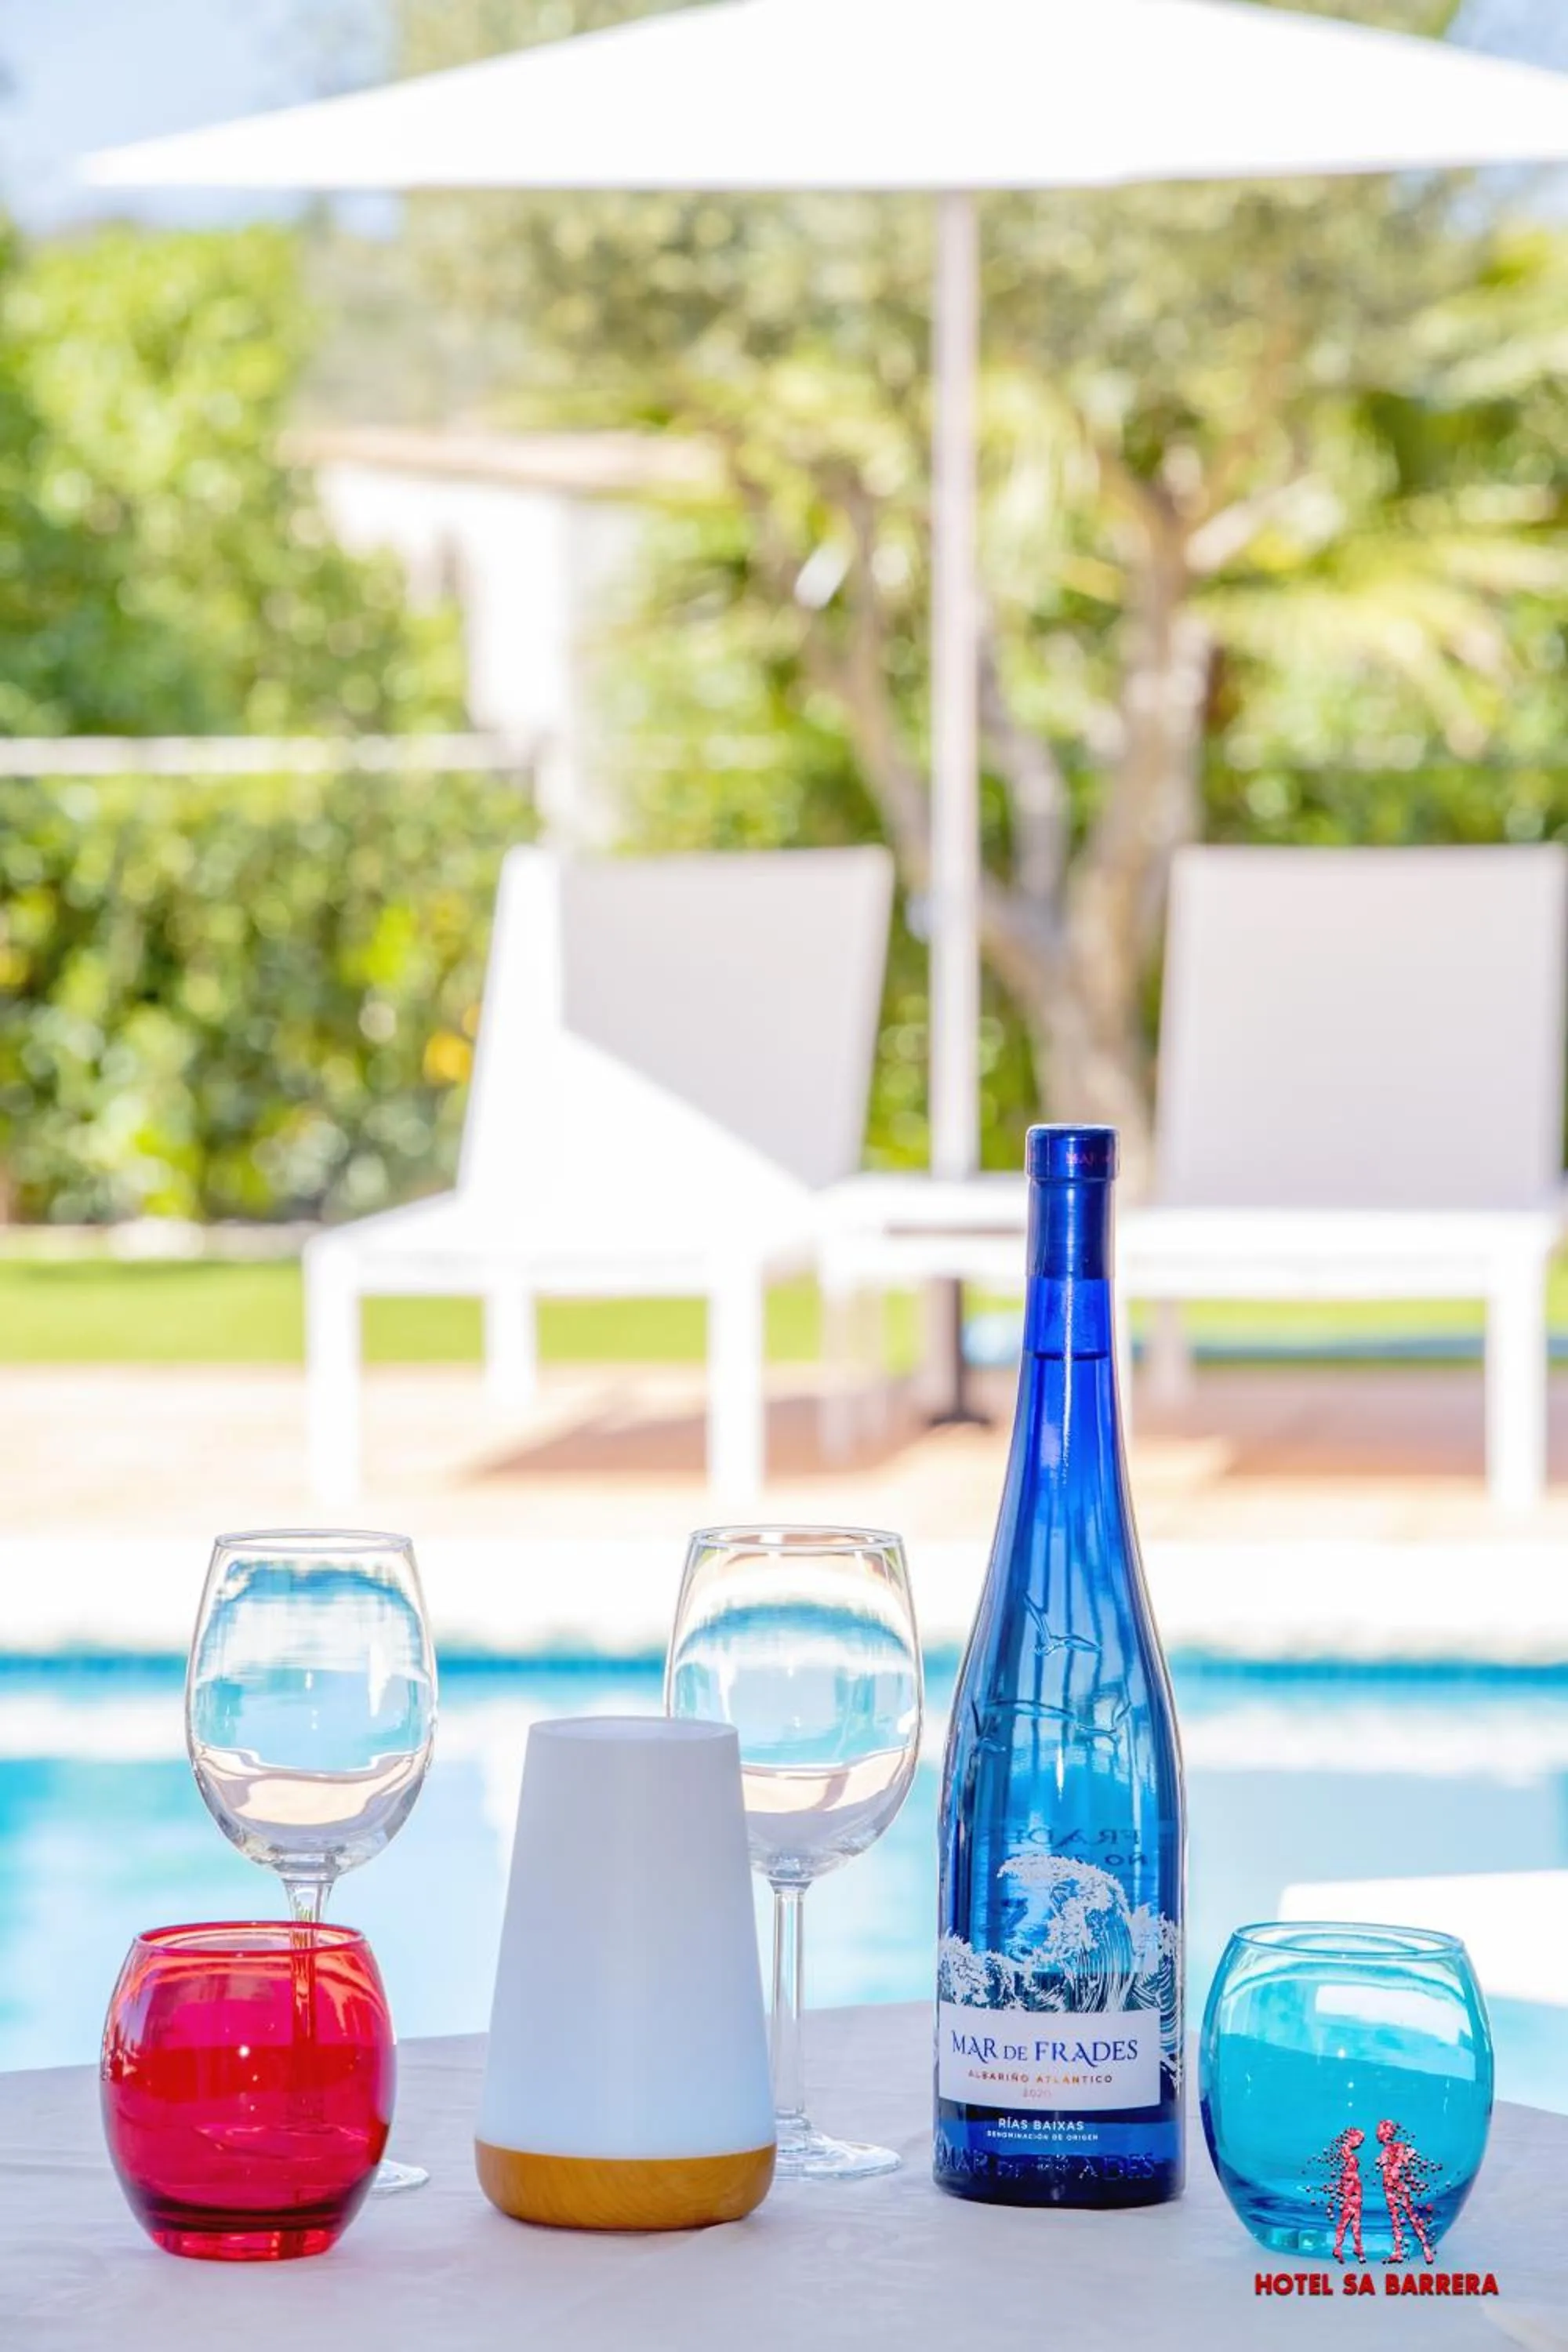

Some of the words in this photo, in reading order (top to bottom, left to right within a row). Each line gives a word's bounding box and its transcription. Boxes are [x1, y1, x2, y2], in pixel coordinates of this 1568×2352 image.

[951, 2029, 998, 2063] MAR
[1004, 2045, 1028, 2061] DE
[1035, 2039, 1138, 2067] FRADES
[968, 2069, 1029, 2083] ALBARIÑO
[998, 2117, 1028, 2130] RÍAS
[1033, 2120, 1084, 2131] BAIXAS
